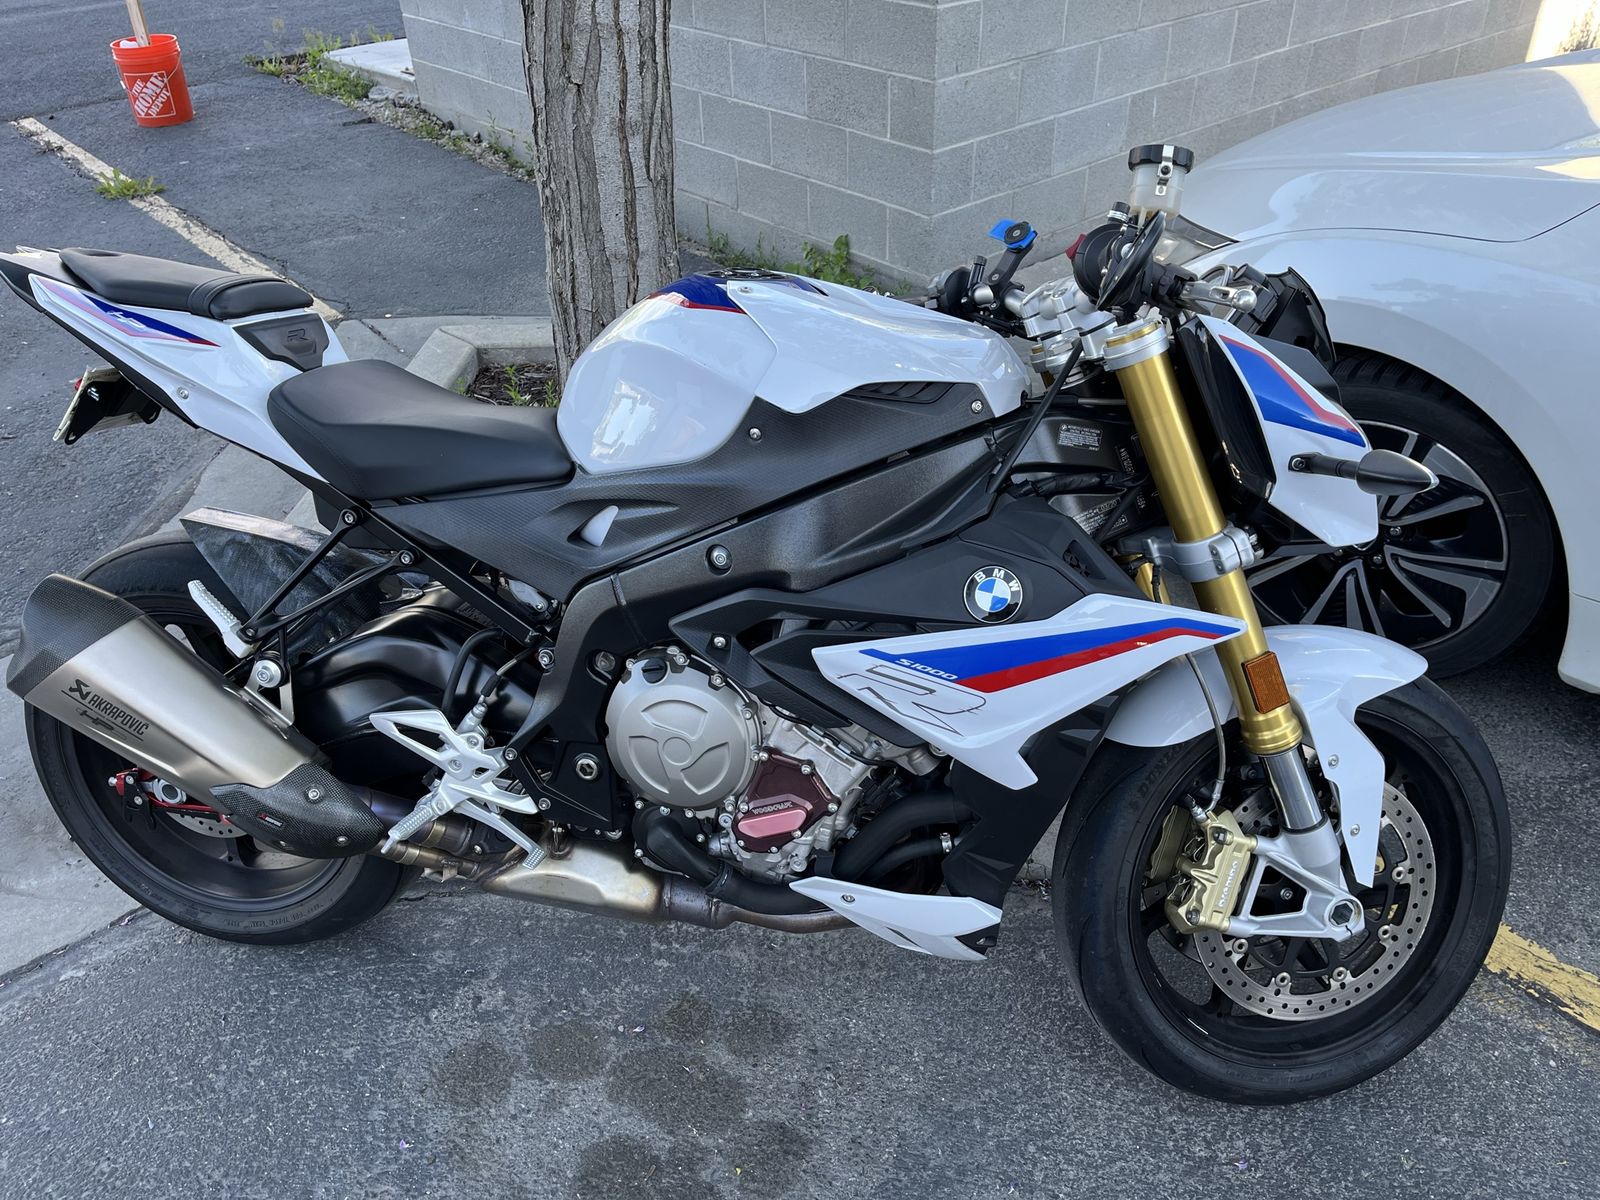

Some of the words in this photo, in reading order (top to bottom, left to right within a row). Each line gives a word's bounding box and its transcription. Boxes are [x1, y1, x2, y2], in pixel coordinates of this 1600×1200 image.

[131, 78, 146, 97] THE
[134, 72, 167, 116] HOME
[148, 87, 171, 117] DEPOT
[974, 568, 1020, 592] BMW
[895, 658, 959, 680] S1000
[1218, 861, 1238, 907] brembo
